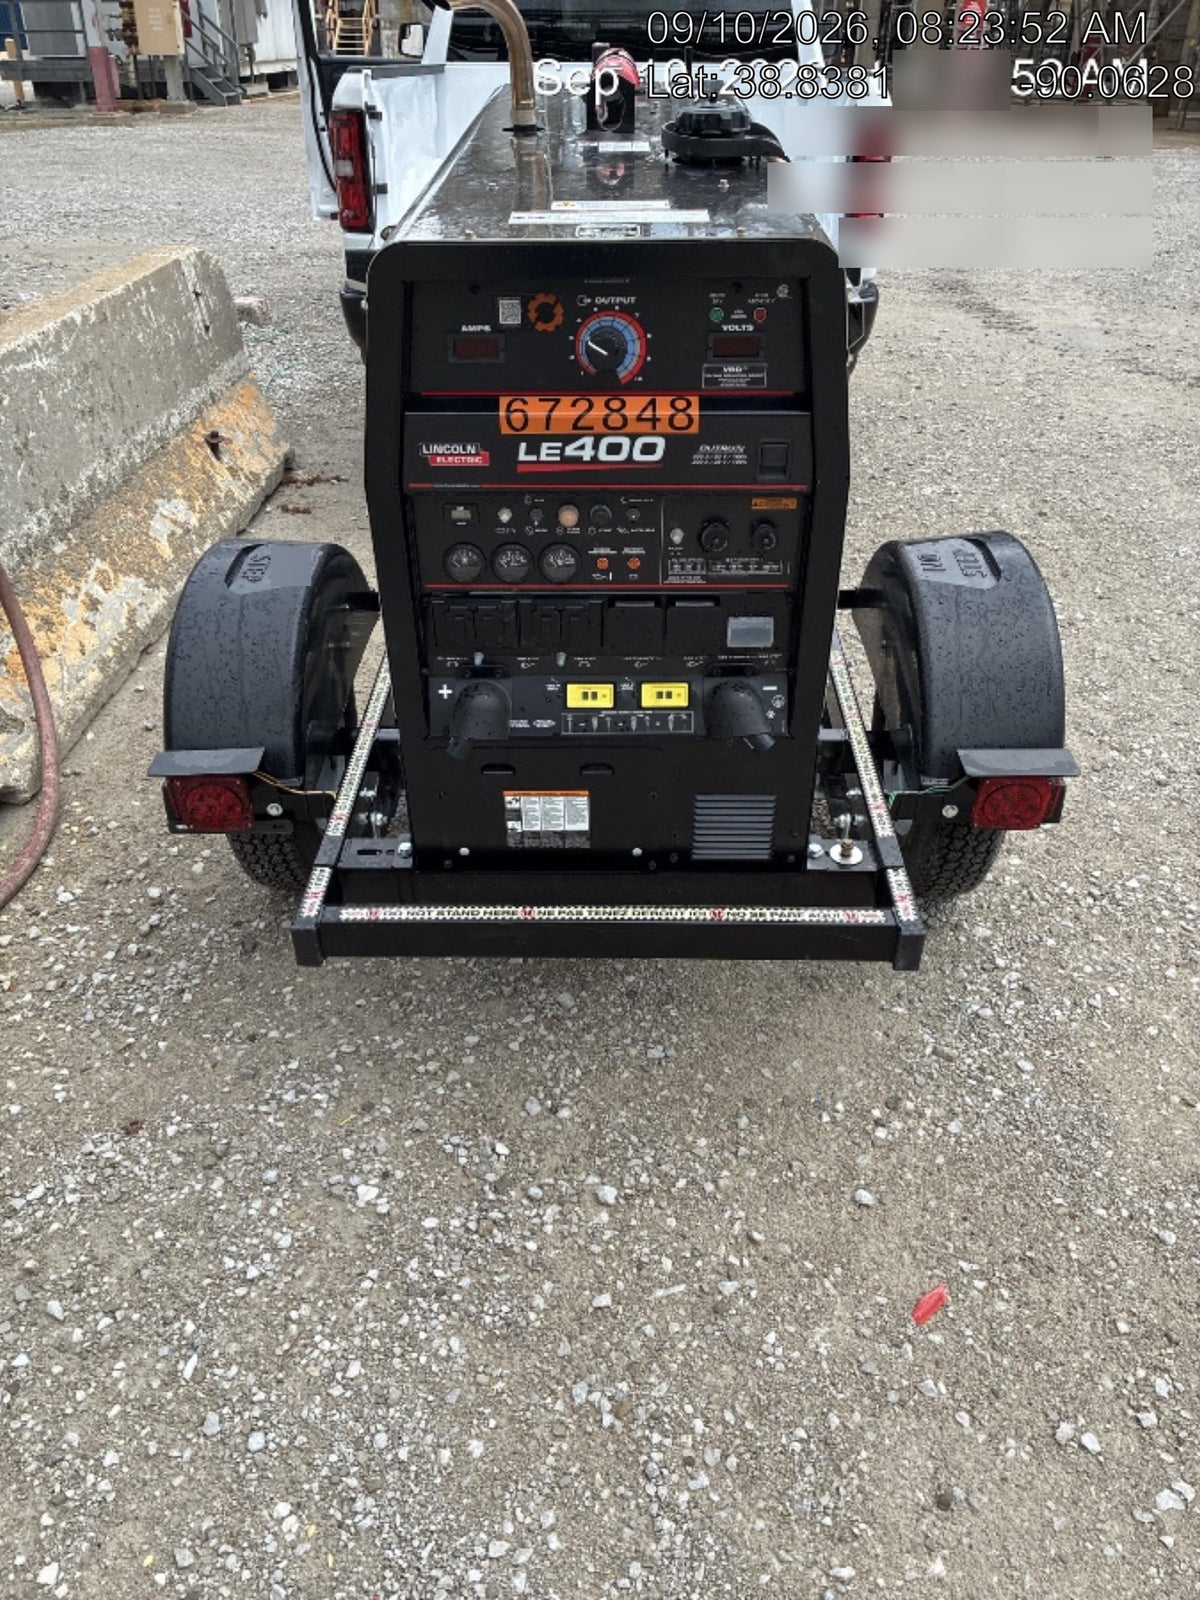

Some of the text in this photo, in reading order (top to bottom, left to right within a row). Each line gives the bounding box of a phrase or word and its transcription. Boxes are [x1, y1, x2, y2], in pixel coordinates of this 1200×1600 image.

[595, 296, 637, 304] OUTPUT
[721, 324, 754, 332] VOLTS
[504, 397, 695, 433] 672848
[422, 443, 477, 454] LINCOLN
[517, 435, 667, 462] LE400
[436, 456, 483, 464] ELECTRIC
[436, 909, 480, 917] STAND
[483, 909, 519, 917] HERE
